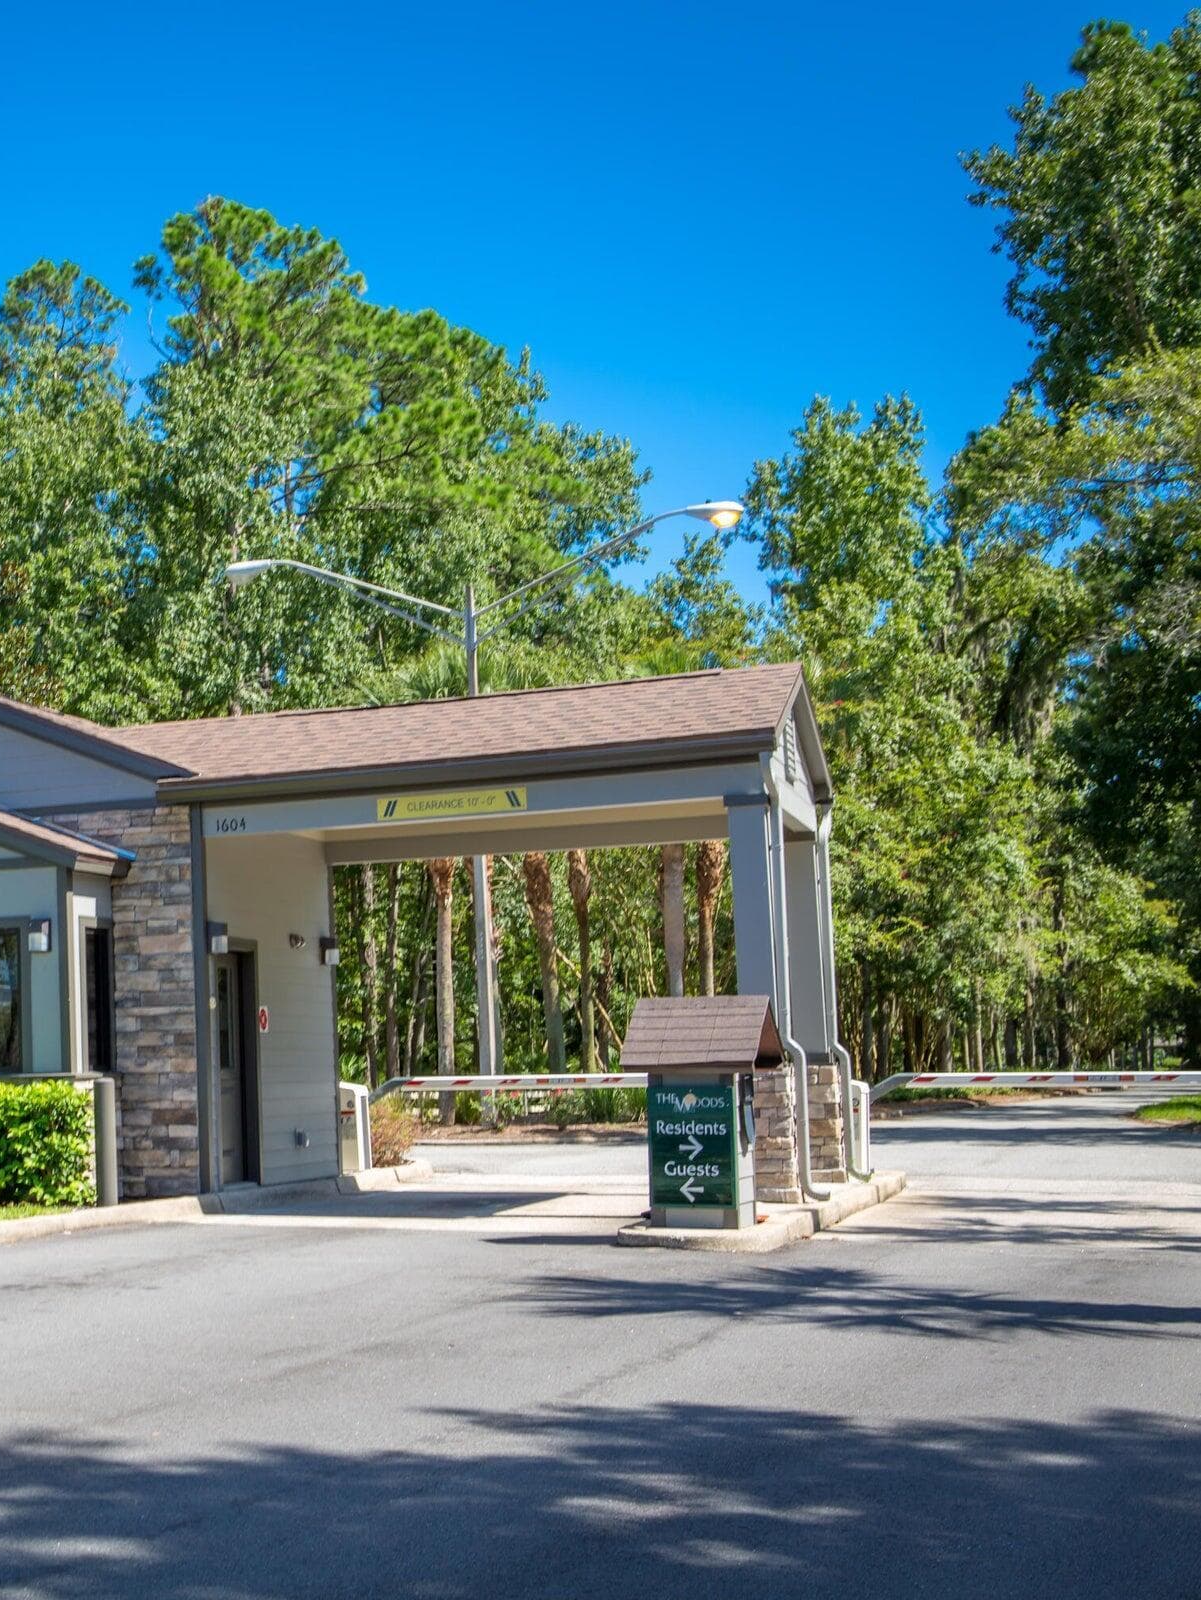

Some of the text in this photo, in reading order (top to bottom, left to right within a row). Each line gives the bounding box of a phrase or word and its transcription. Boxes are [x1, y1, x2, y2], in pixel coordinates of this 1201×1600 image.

[406, 798, 464, 812] CLEARANCE
[216, 817, 246, 832] 1604
[656, 1093, 676, 1104] THE
[656, 1120, 727, 1135] Residents
[664, 1160, 720, 1177] Guests
